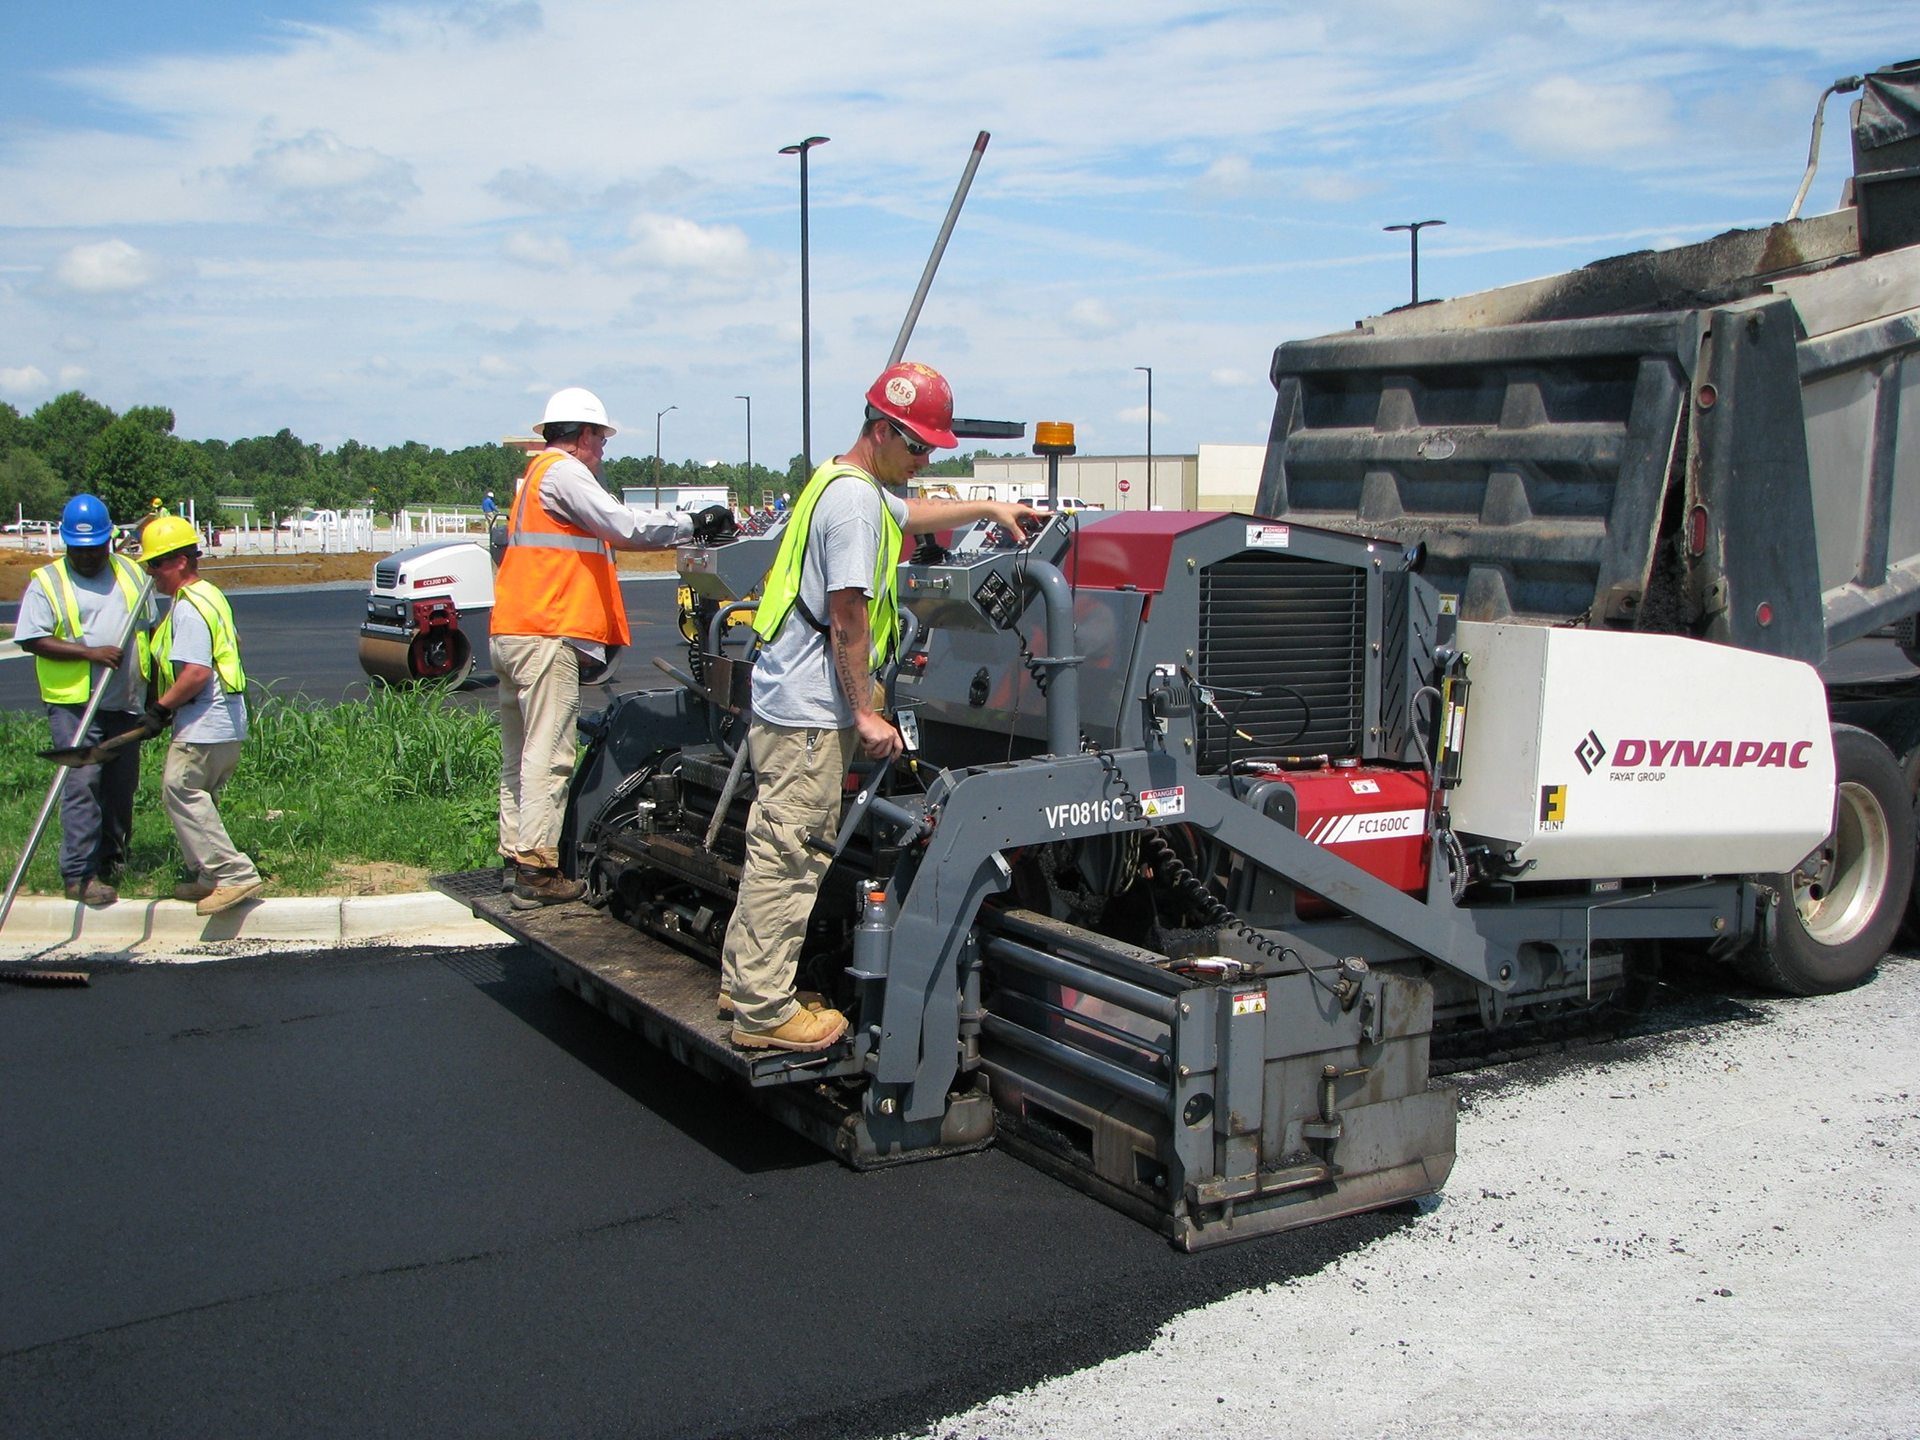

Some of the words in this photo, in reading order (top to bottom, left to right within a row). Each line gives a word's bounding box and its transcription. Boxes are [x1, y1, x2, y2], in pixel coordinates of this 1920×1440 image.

[1611, 740, 1813, 769] DYNAPAC
[1609, 772, 1635, 782] FAYAT
[1637, 772, 1666, 782] GROUP
[1152, 788, 1178, 799] DANGER
[1045, 797, 1124, 829] VF0816C
[1358, 816, 1410, 834] FC1600C
[1539, 821, 1565, 831] FLINT
